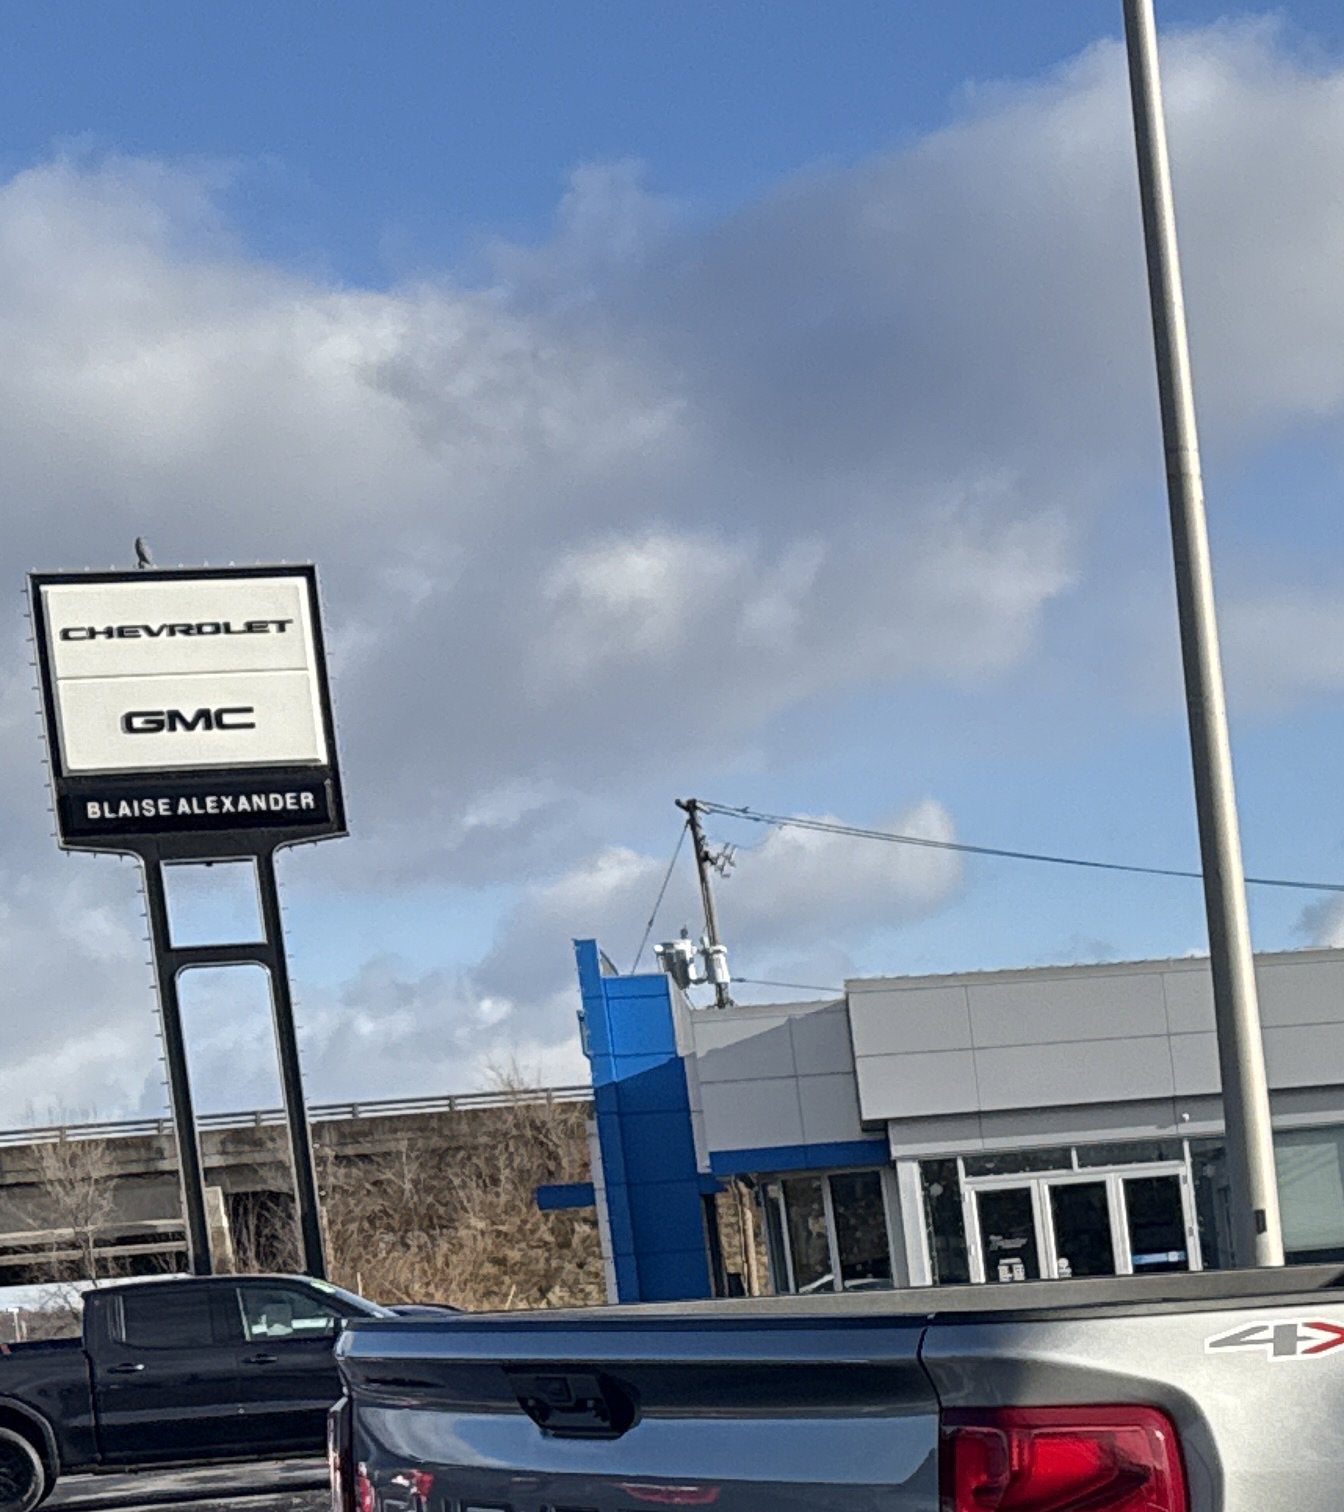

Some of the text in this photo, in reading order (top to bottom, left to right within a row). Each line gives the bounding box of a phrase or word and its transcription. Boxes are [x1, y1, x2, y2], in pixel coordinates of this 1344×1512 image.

[59, 618, 293, 641] CHEVROLET
[121, 706, 256, 734] GMC
[87, 791, 315, 819] BLAISE ALEXANDER
